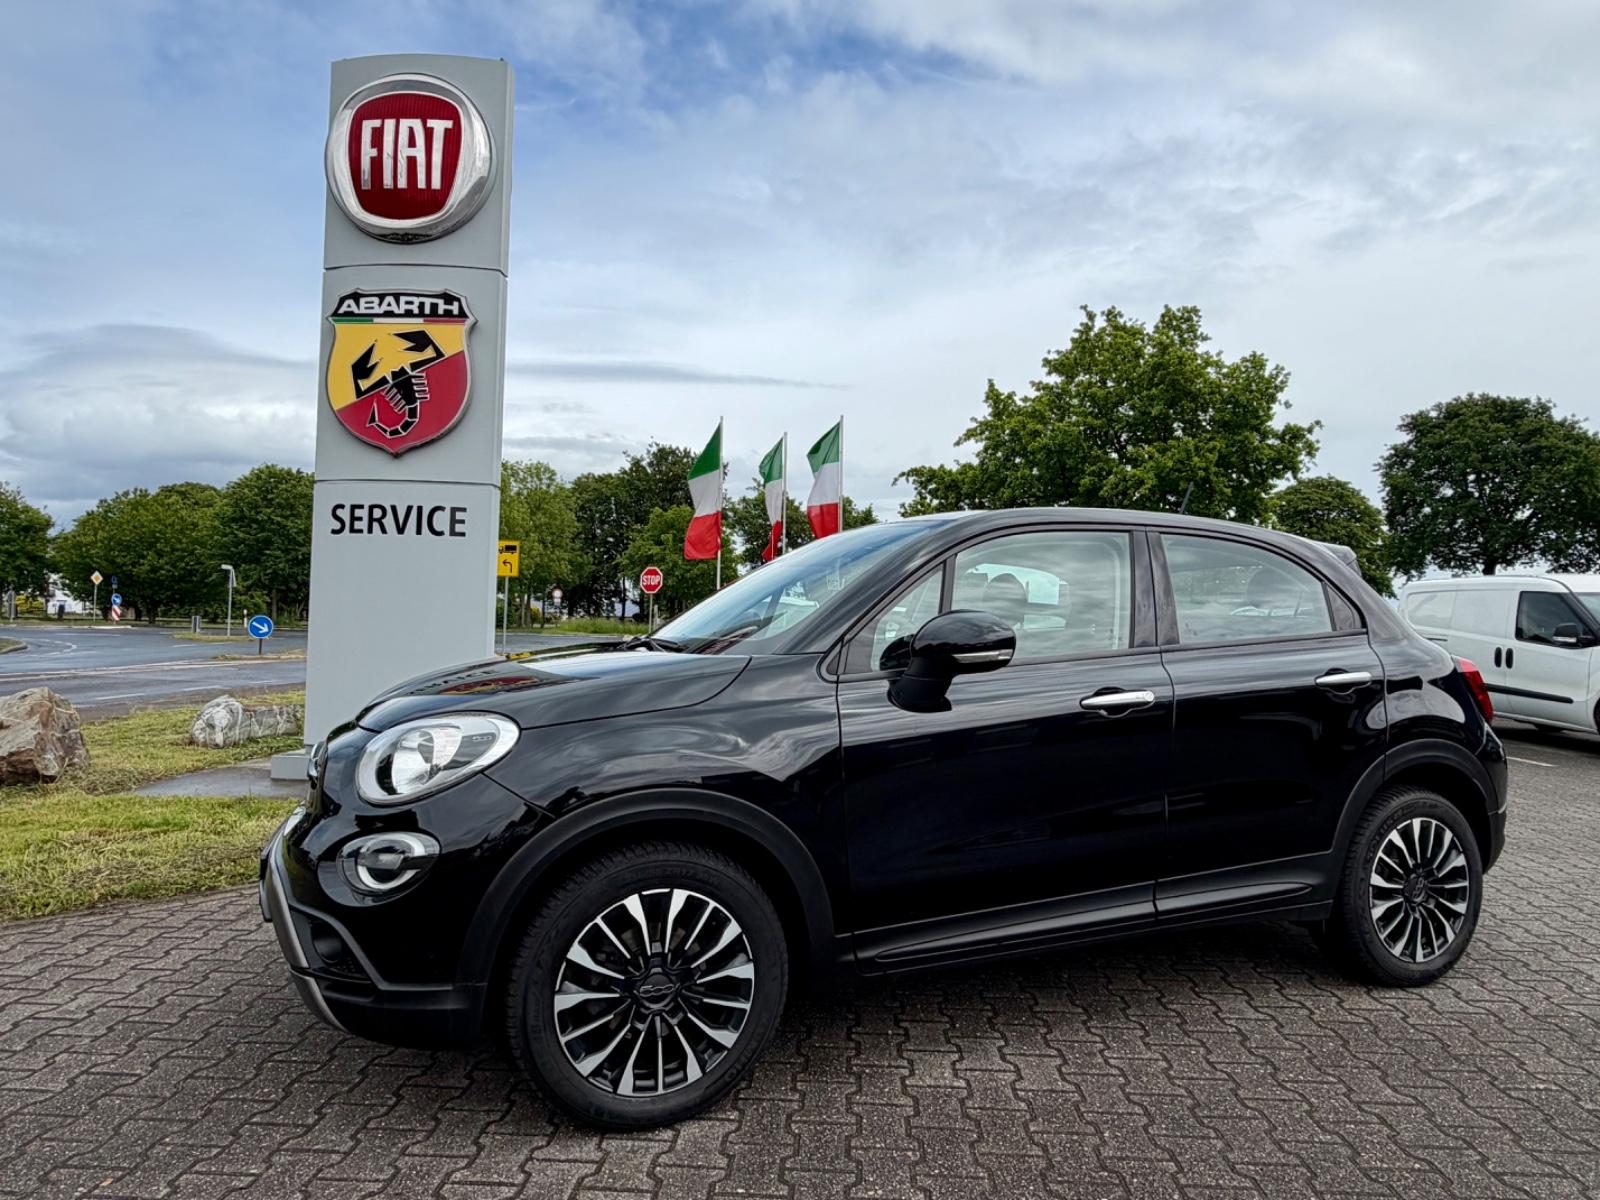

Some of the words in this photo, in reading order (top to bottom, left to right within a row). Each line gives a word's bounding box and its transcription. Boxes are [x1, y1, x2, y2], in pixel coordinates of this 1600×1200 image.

[360, 118, 454, 190] FIAT
[337, 295, 460, 316] ABARTH
[330, 503, 467, 538] SERVICE
[642, 574, 661, 586] STOP
